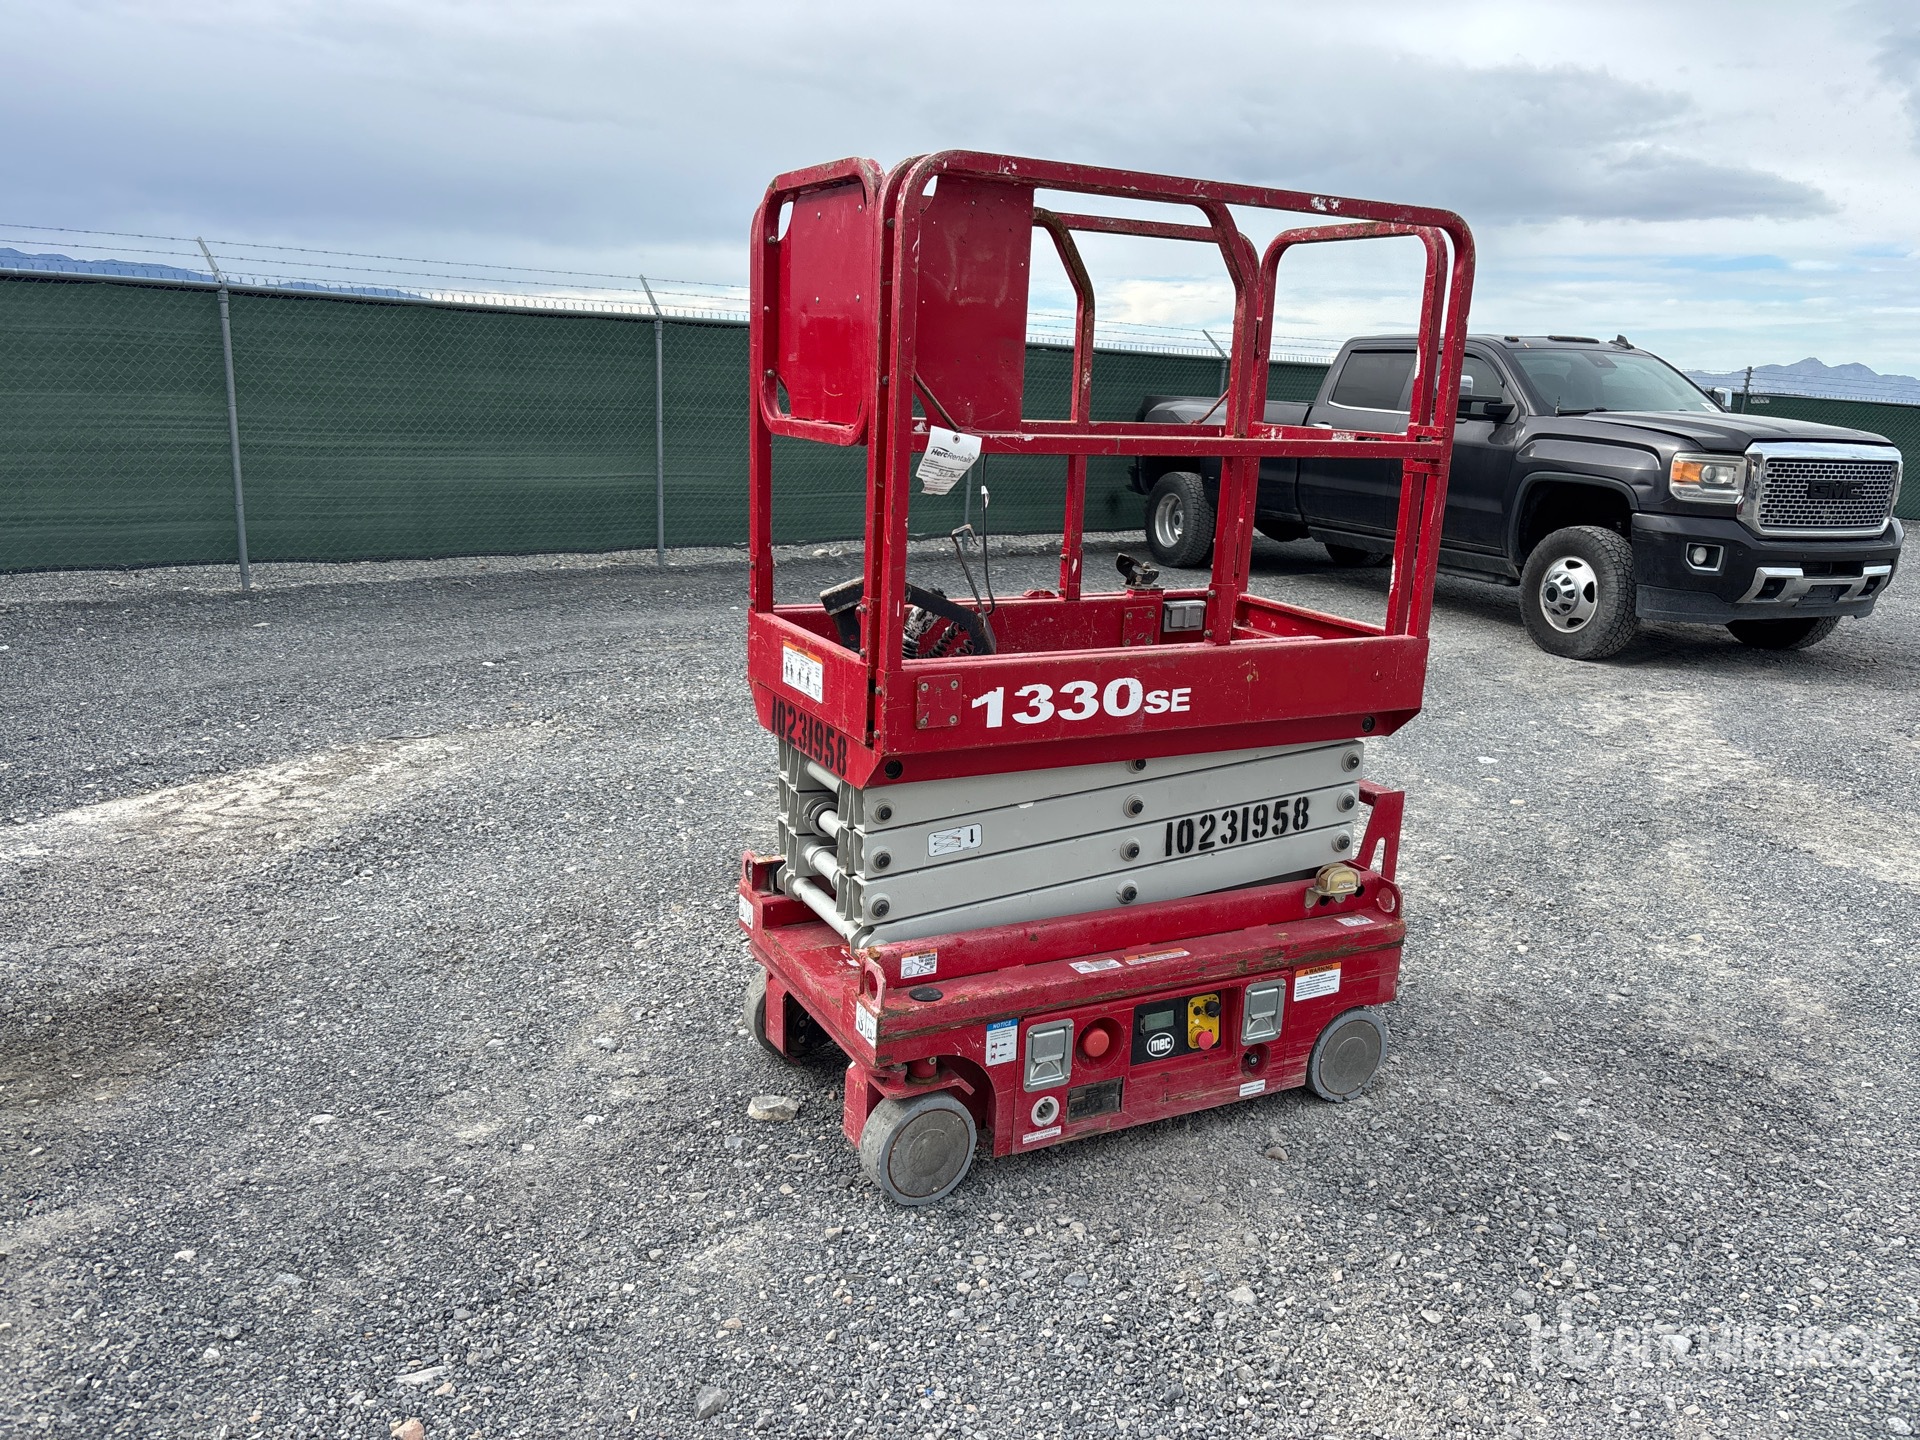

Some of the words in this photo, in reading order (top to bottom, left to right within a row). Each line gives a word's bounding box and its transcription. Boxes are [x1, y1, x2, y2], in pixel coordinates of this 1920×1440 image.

[930, 448, 972, 463] HercRentals
[1809, 480, 1864, 499] GMC
[771, 695, 847, 777] 10231958
[1165, 796, 1310, 857] 10231958
[1309, 964, 1334, 974] WARNING
[992, 1020, 1012, 1030] NOTICE
[1150, 1037, 1171, 1053] mec
